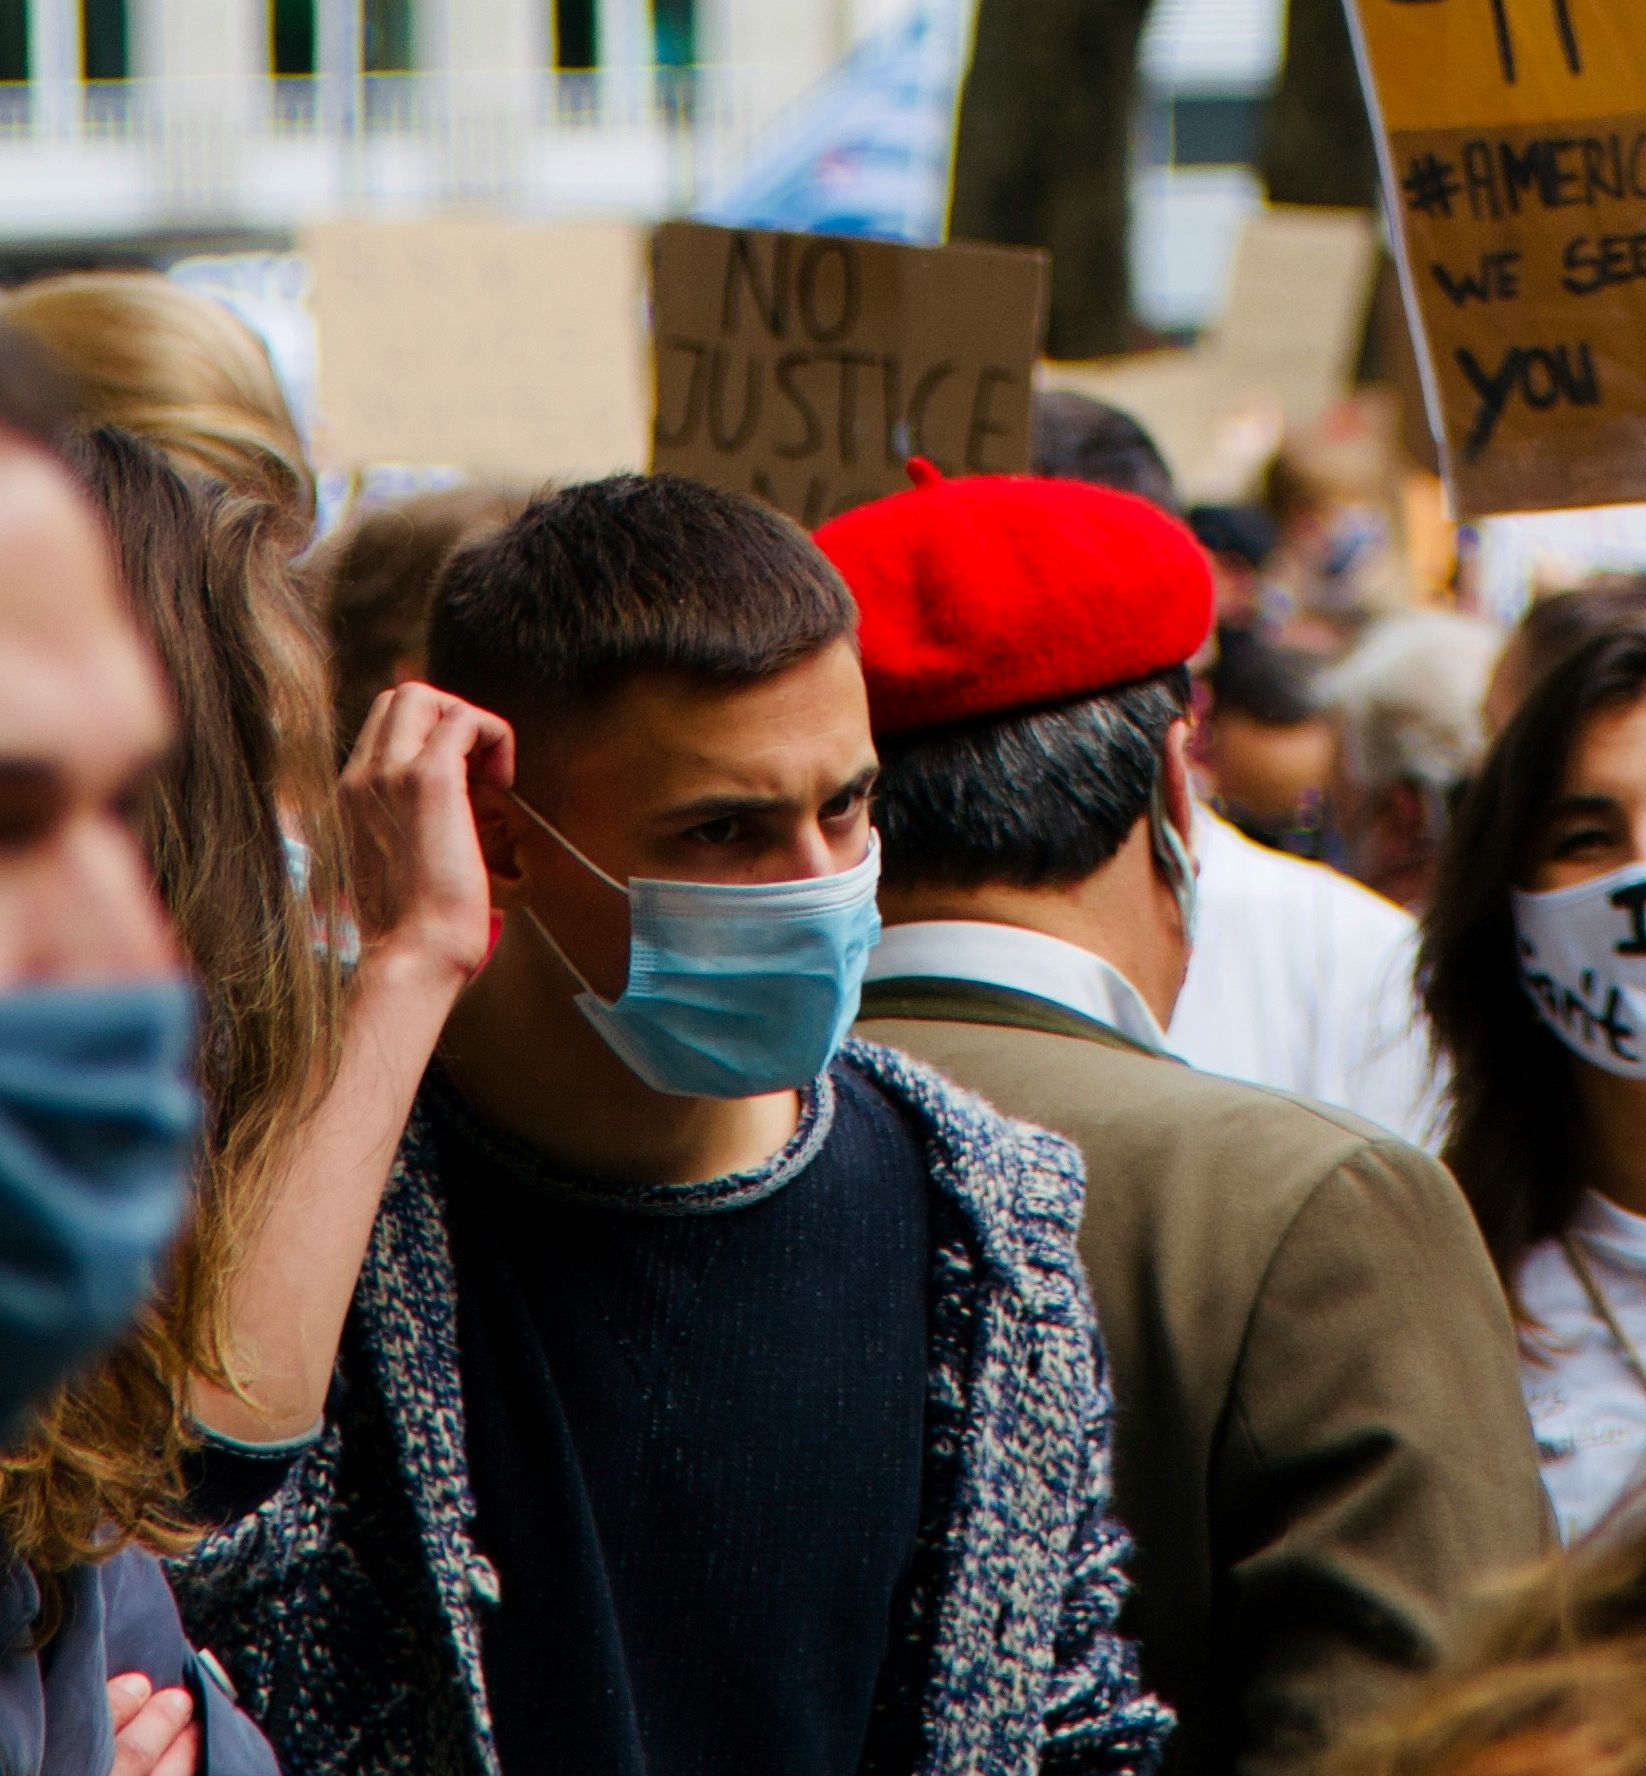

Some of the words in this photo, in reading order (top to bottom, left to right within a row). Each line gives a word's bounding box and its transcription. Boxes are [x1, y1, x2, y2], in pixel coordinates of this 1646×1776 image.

[719, 230, 863, 343] NO
[1430, 250, 1522, 308] WE
[657, 331, 1017, 472] JUSTICE
[1453, 342, 1602, 466] YOU
